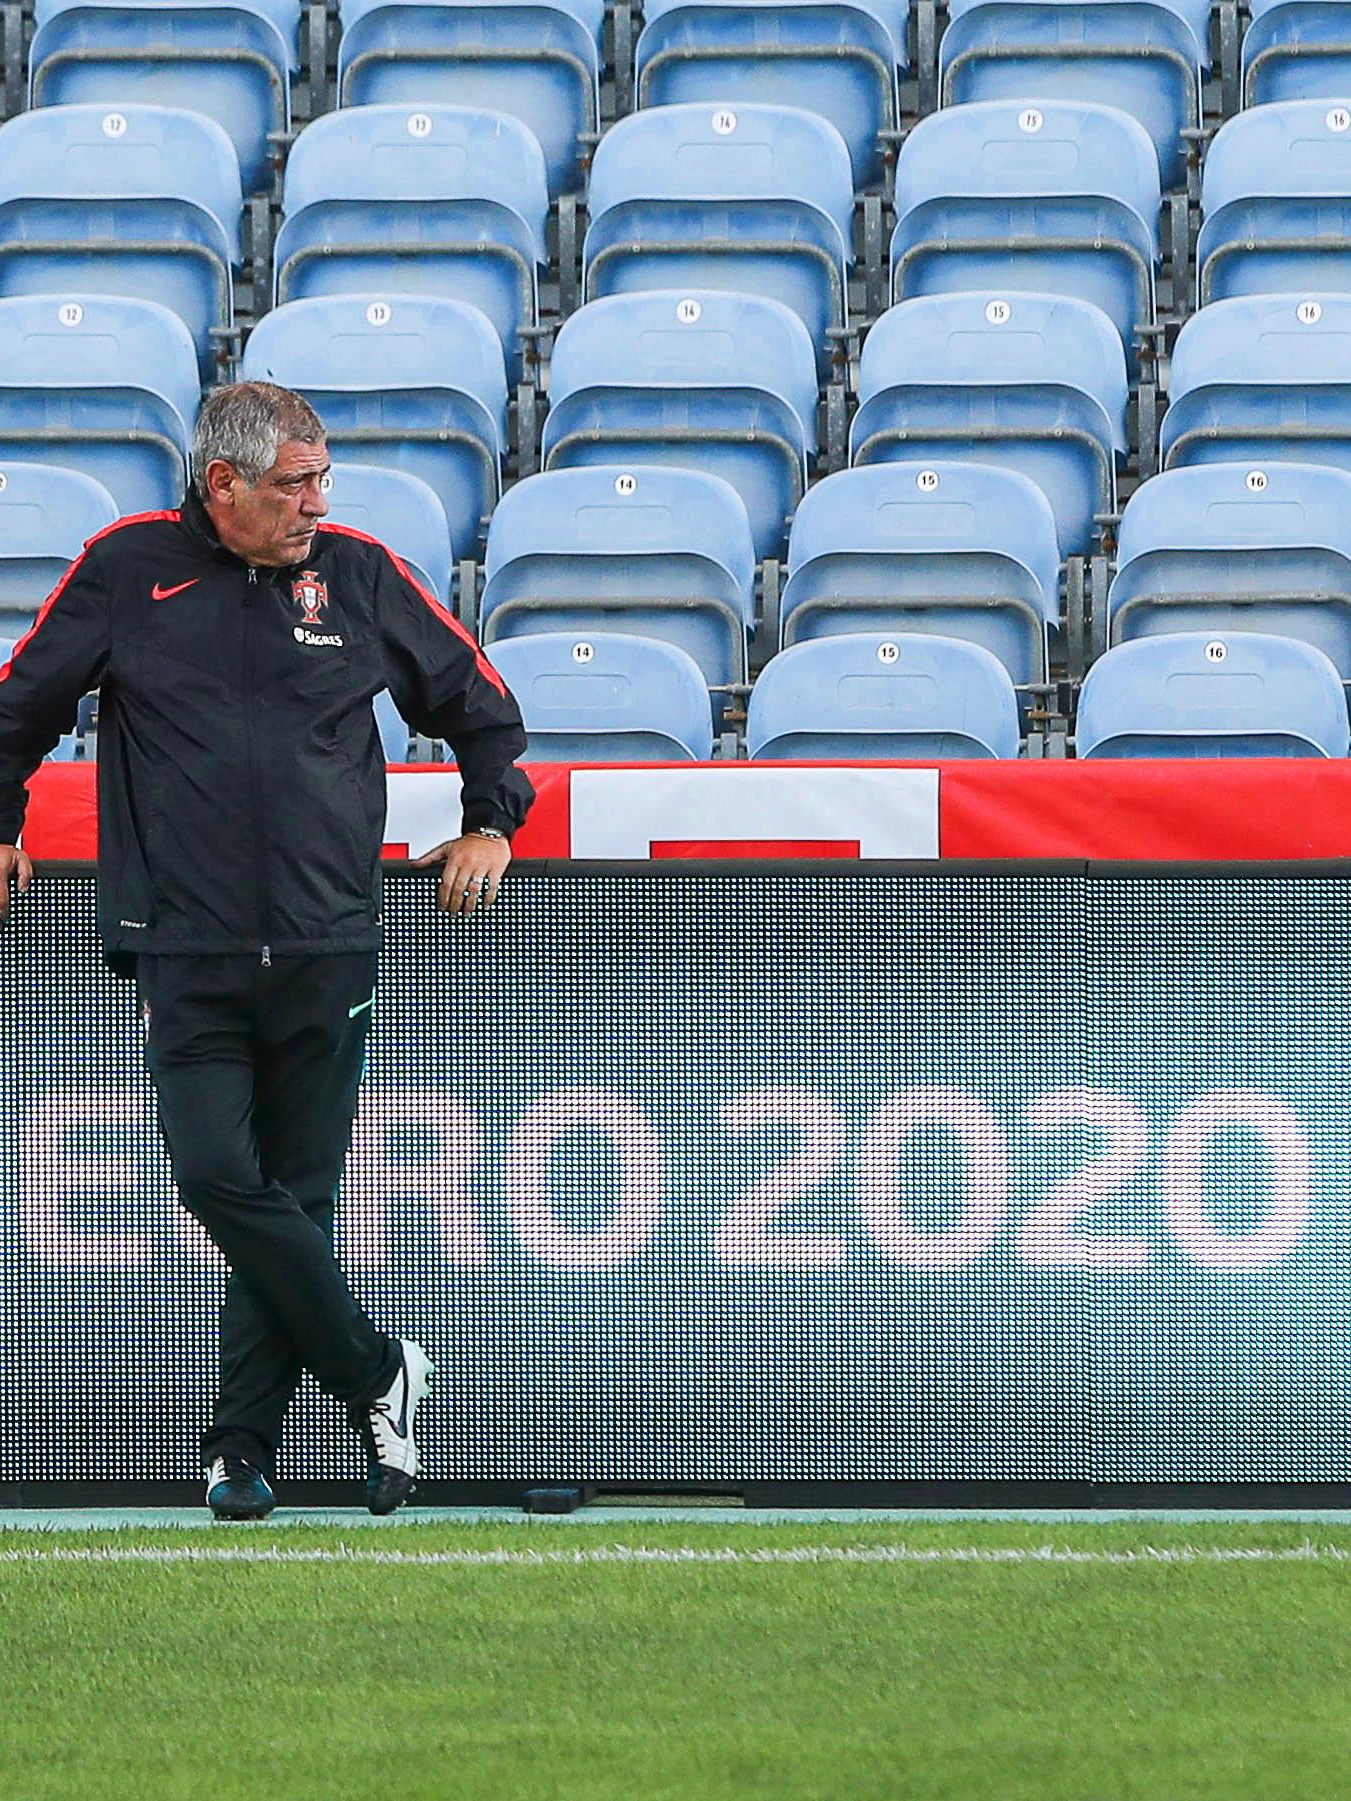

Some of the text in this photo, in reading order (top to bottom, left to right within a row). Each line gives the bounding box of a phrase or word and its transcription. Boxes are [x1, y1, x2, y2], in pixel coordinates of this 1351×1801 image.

[1334, 113, 1345, 126] 16
[67, 308, 78, 320] 12
[374, 308, 385, 320] 13
[685, 305, 695, 317] 14
[994, 306, 1004, 318] 15
[1305, 306, 1315, 318] 16
[621, 479, 632, 489] 14
[923, 475, 935, 486] 15
[1251, 477, 1264, 487] 16
[577, 647, 589, 657] 14
[883, 647, 895, 658] 15
[1210, 647, 1223, 658] 16
[21, 1086, 660, 1271] ERO
[712, 1084, 1312, 1272] 2020
